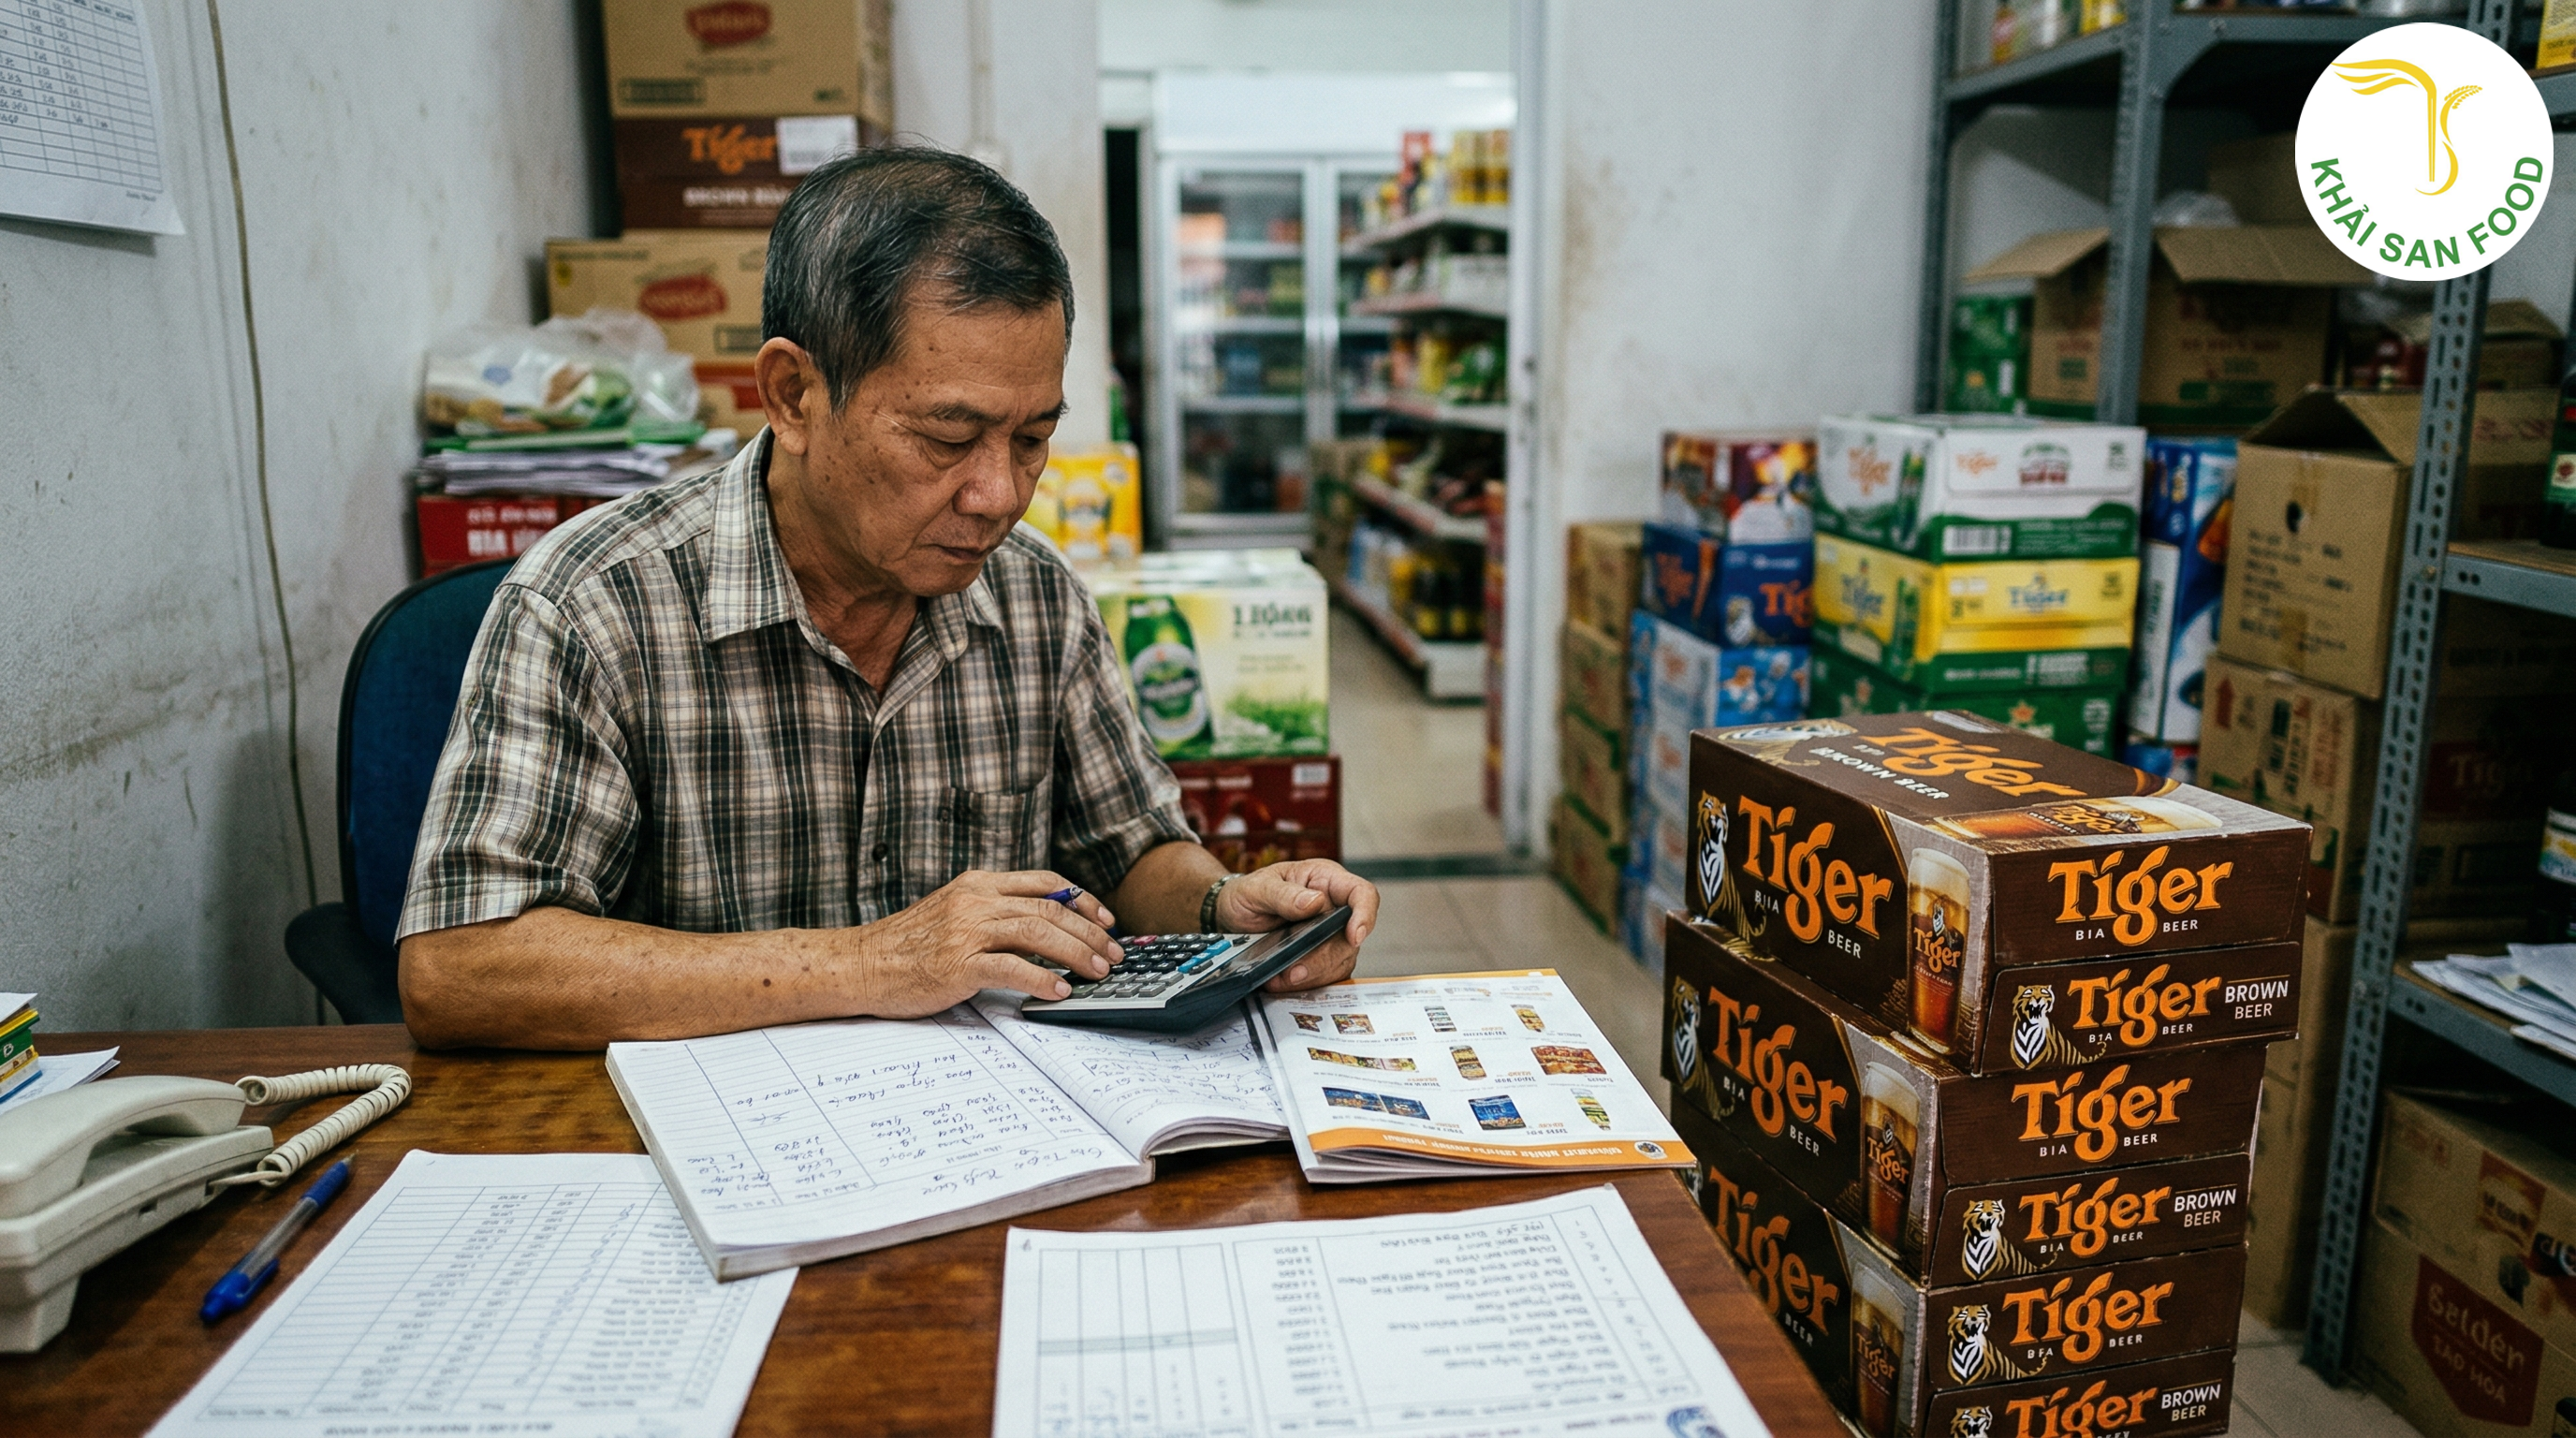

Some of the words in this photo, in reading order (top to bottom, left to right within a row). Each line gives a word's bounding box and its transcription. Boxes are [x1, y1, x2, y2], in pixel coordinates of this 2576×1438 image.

[1759, 579, 1814, 628] Tig
[1860, 727, 2088, 799] Tiger
[1738, 795, 1894, 945] Tiger
[2048, 845, 2234, 946] Tiger
[1828, 930, 1862, 960] BEER
[1913, 926, 1961, 973] Tiger
[2075, 928, 2105, 941] BIA
[2162, 918, 2199, 933] BEER
[2067, 963, 2222, 1048] Tiger
[2224, 980, 2289, 1004] BROWN
[2234, 1003, 2273, 1020] BEER
[2162, 1023, 2193, 1035] BEER
[1708, 986, 1849, 1143] Tiger
[2012, 1064, 2193, 1163] Tiger
[1790, 1124, 1820, 1156] BEER
[1867, 1136, 1910, 1184] Tiger
[2040, 1144, 2068, 1157] BIA
[2123, 1133, 2158, 1147] BEER
[2018, 1177, 2173, 1258] Tiger
[2174, 1188, 2237, 1212] BROWN
[2183, 1211, 2221, 1227] BEER
[1708, 1166, 1840, 1335] Tiger
[2040, 1242, 2064, 1254] BIA
[2002, 1271, 2174, 1364] Tiger
[2005, 1380, 2158, 1438] Tiger
[2161, 1384, 2221, 1410] BROWN
[2171, 1405, 2207, 1422] BEER
